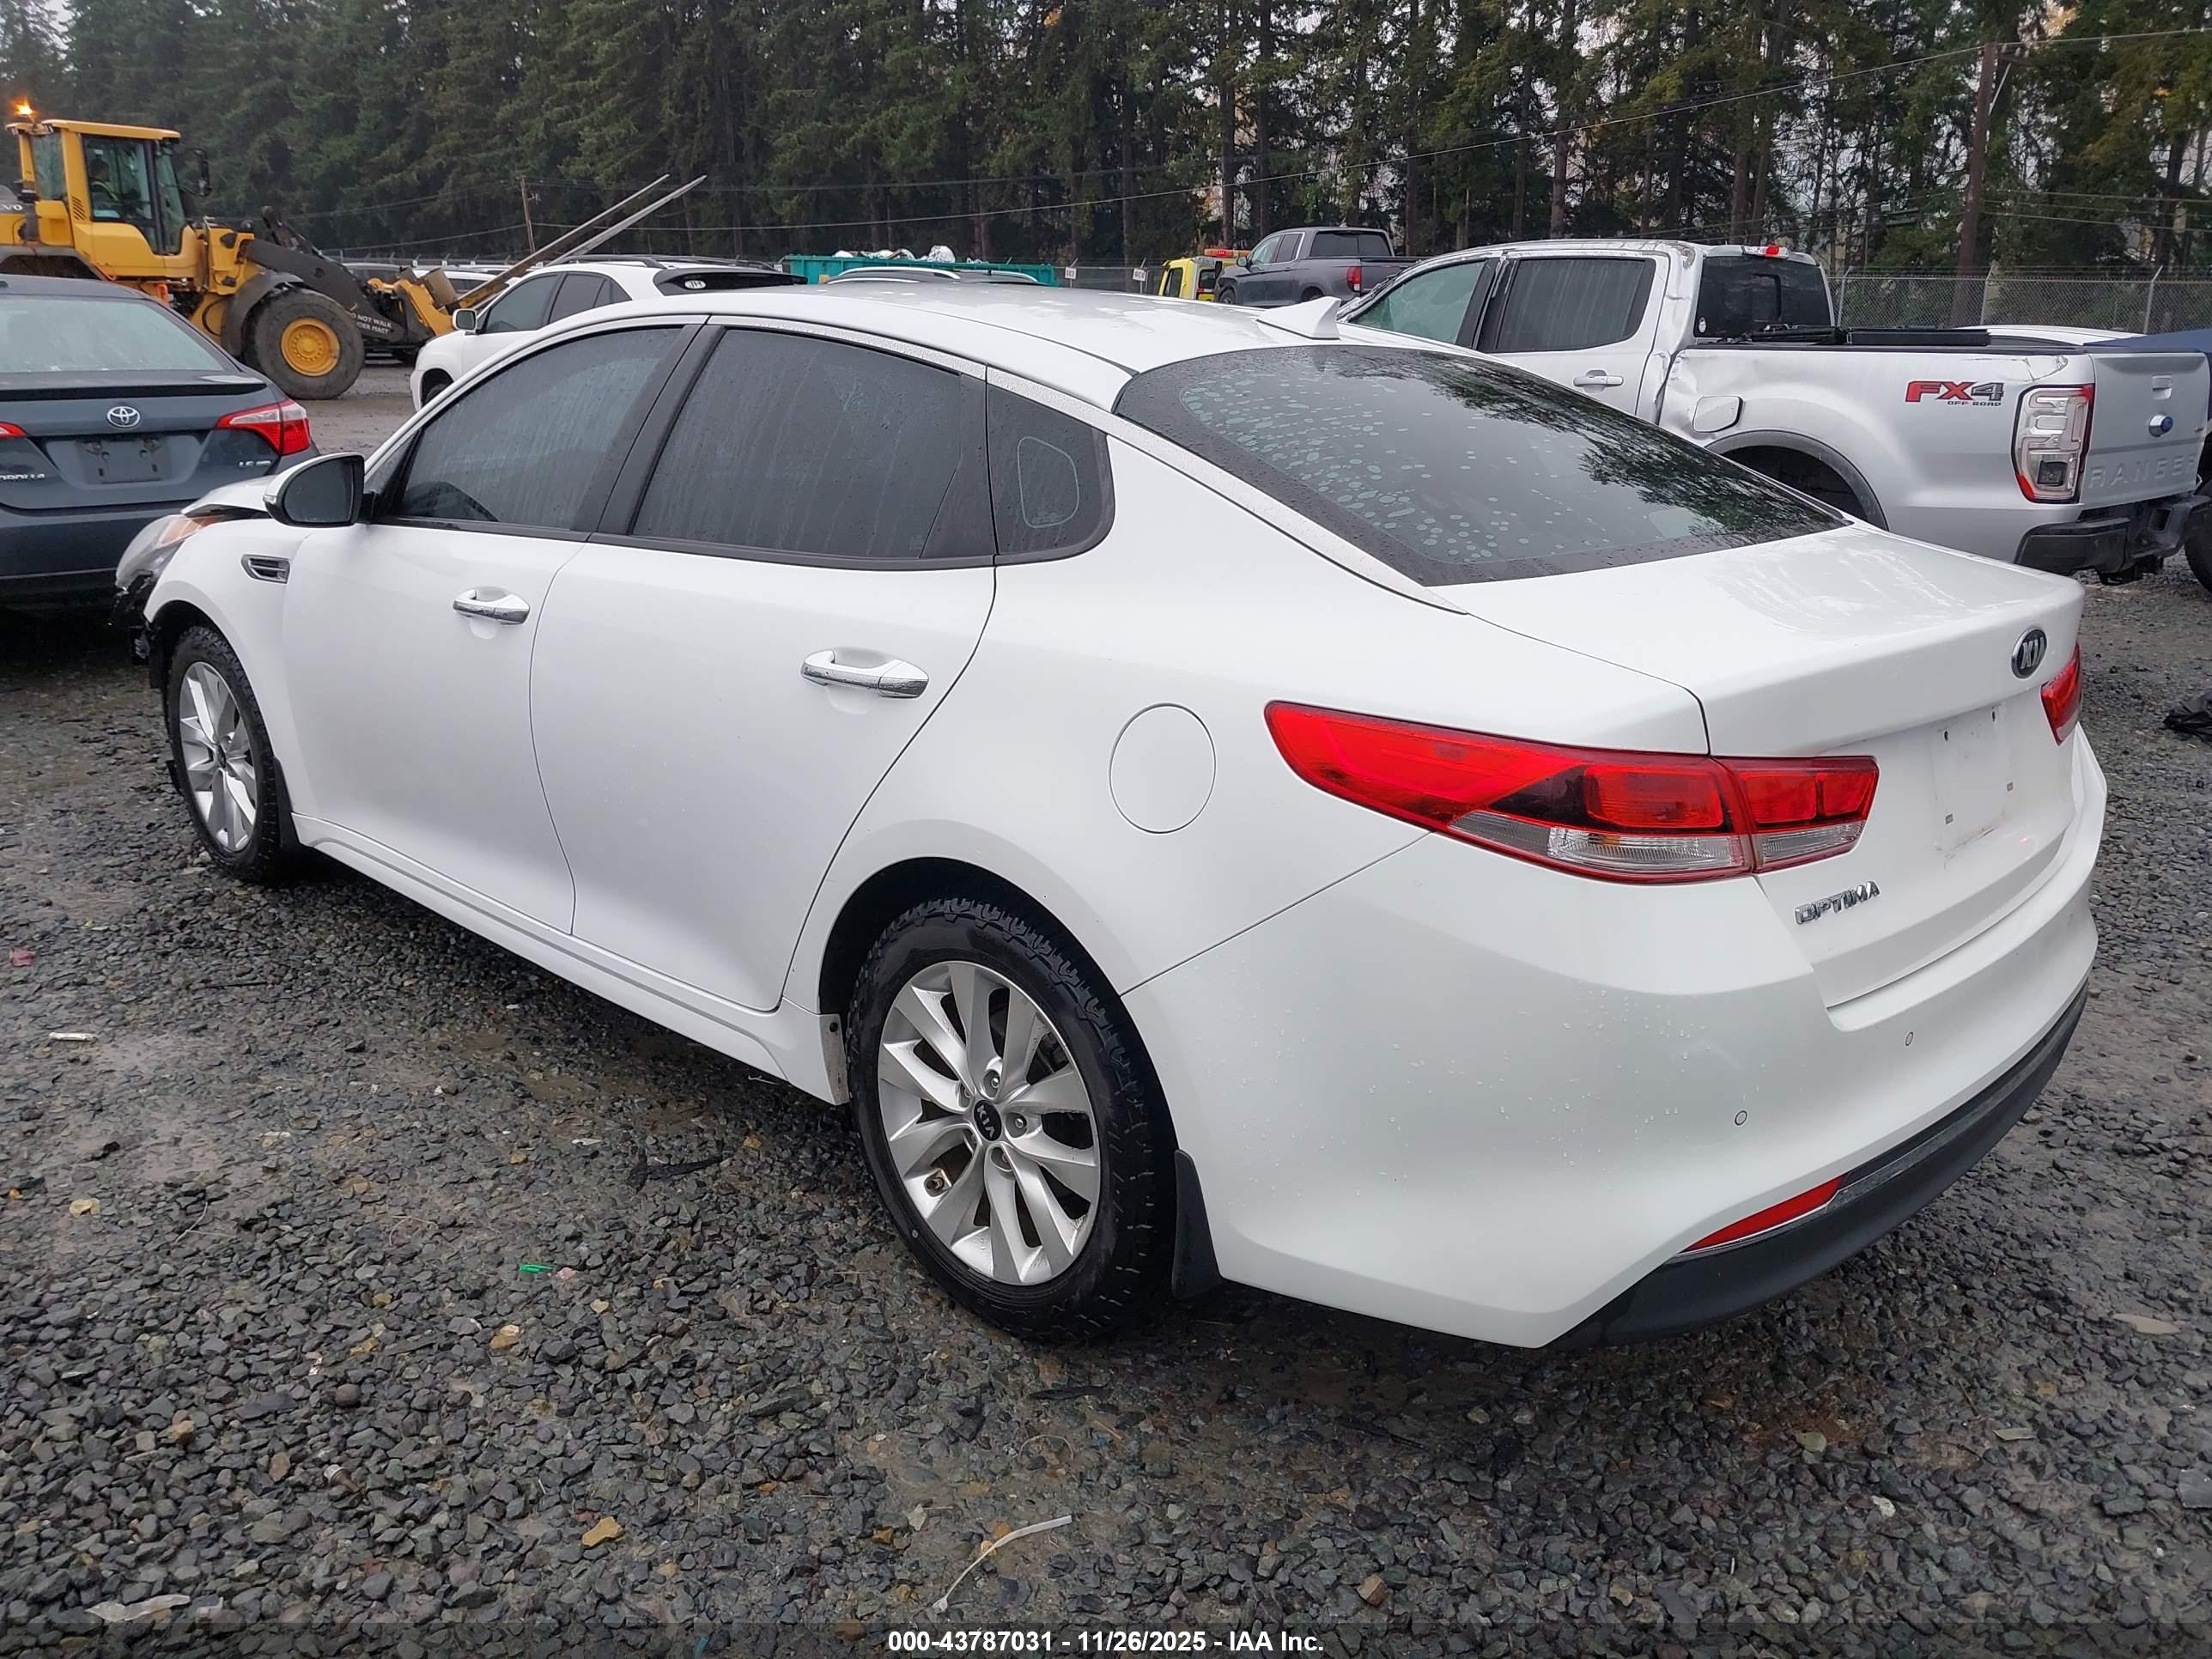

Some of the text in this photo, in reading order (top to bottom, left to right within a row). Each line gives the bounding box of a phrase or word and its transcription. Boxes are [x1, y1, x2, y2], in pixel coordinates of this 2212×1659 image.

[373, 318, 392, 328] WALK
[1905, 380, 2004, 402] FX4
[1795, 881, 1881, 925] OPTIMA
[976, 1104, 995, 1139] KIA
